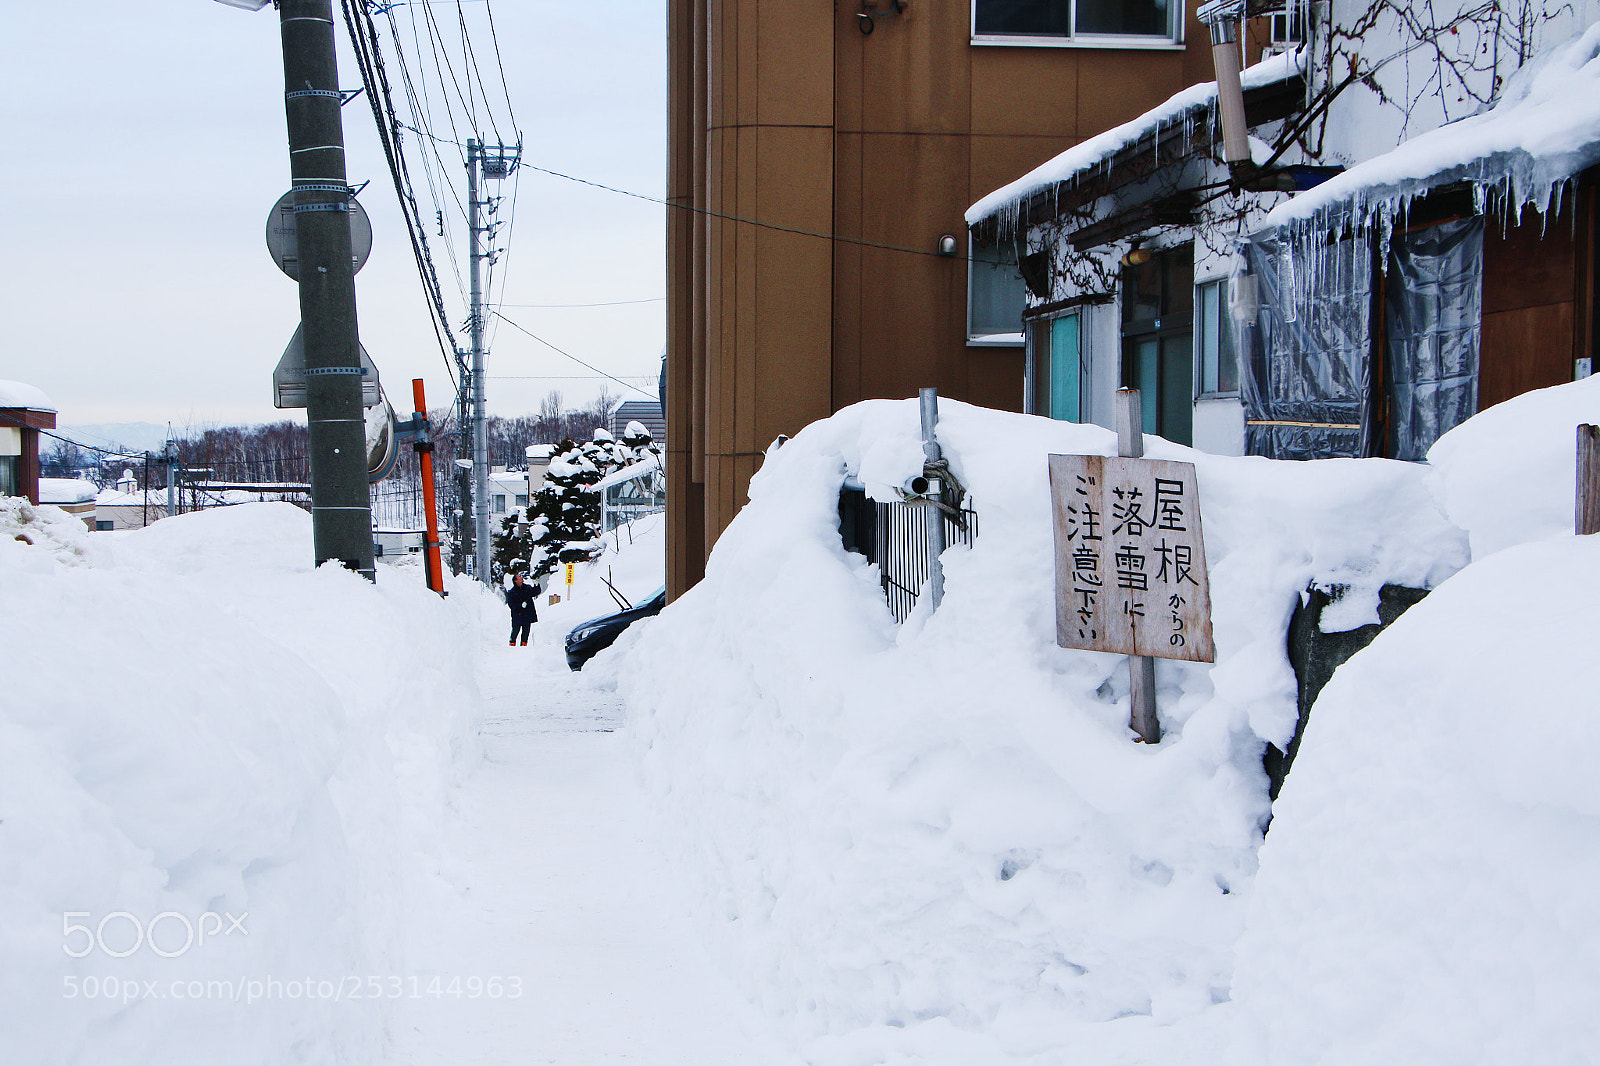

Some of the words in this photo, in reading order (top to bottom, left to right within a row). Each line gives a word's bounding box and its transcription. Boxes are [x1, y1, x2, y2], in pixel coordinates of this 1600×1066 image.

[1067, 475, 1103, 640] ご注意下さい
[1112, 486, 1149, 617] 落雪に
[1150, 477, 1199, 647] 屋根からの
